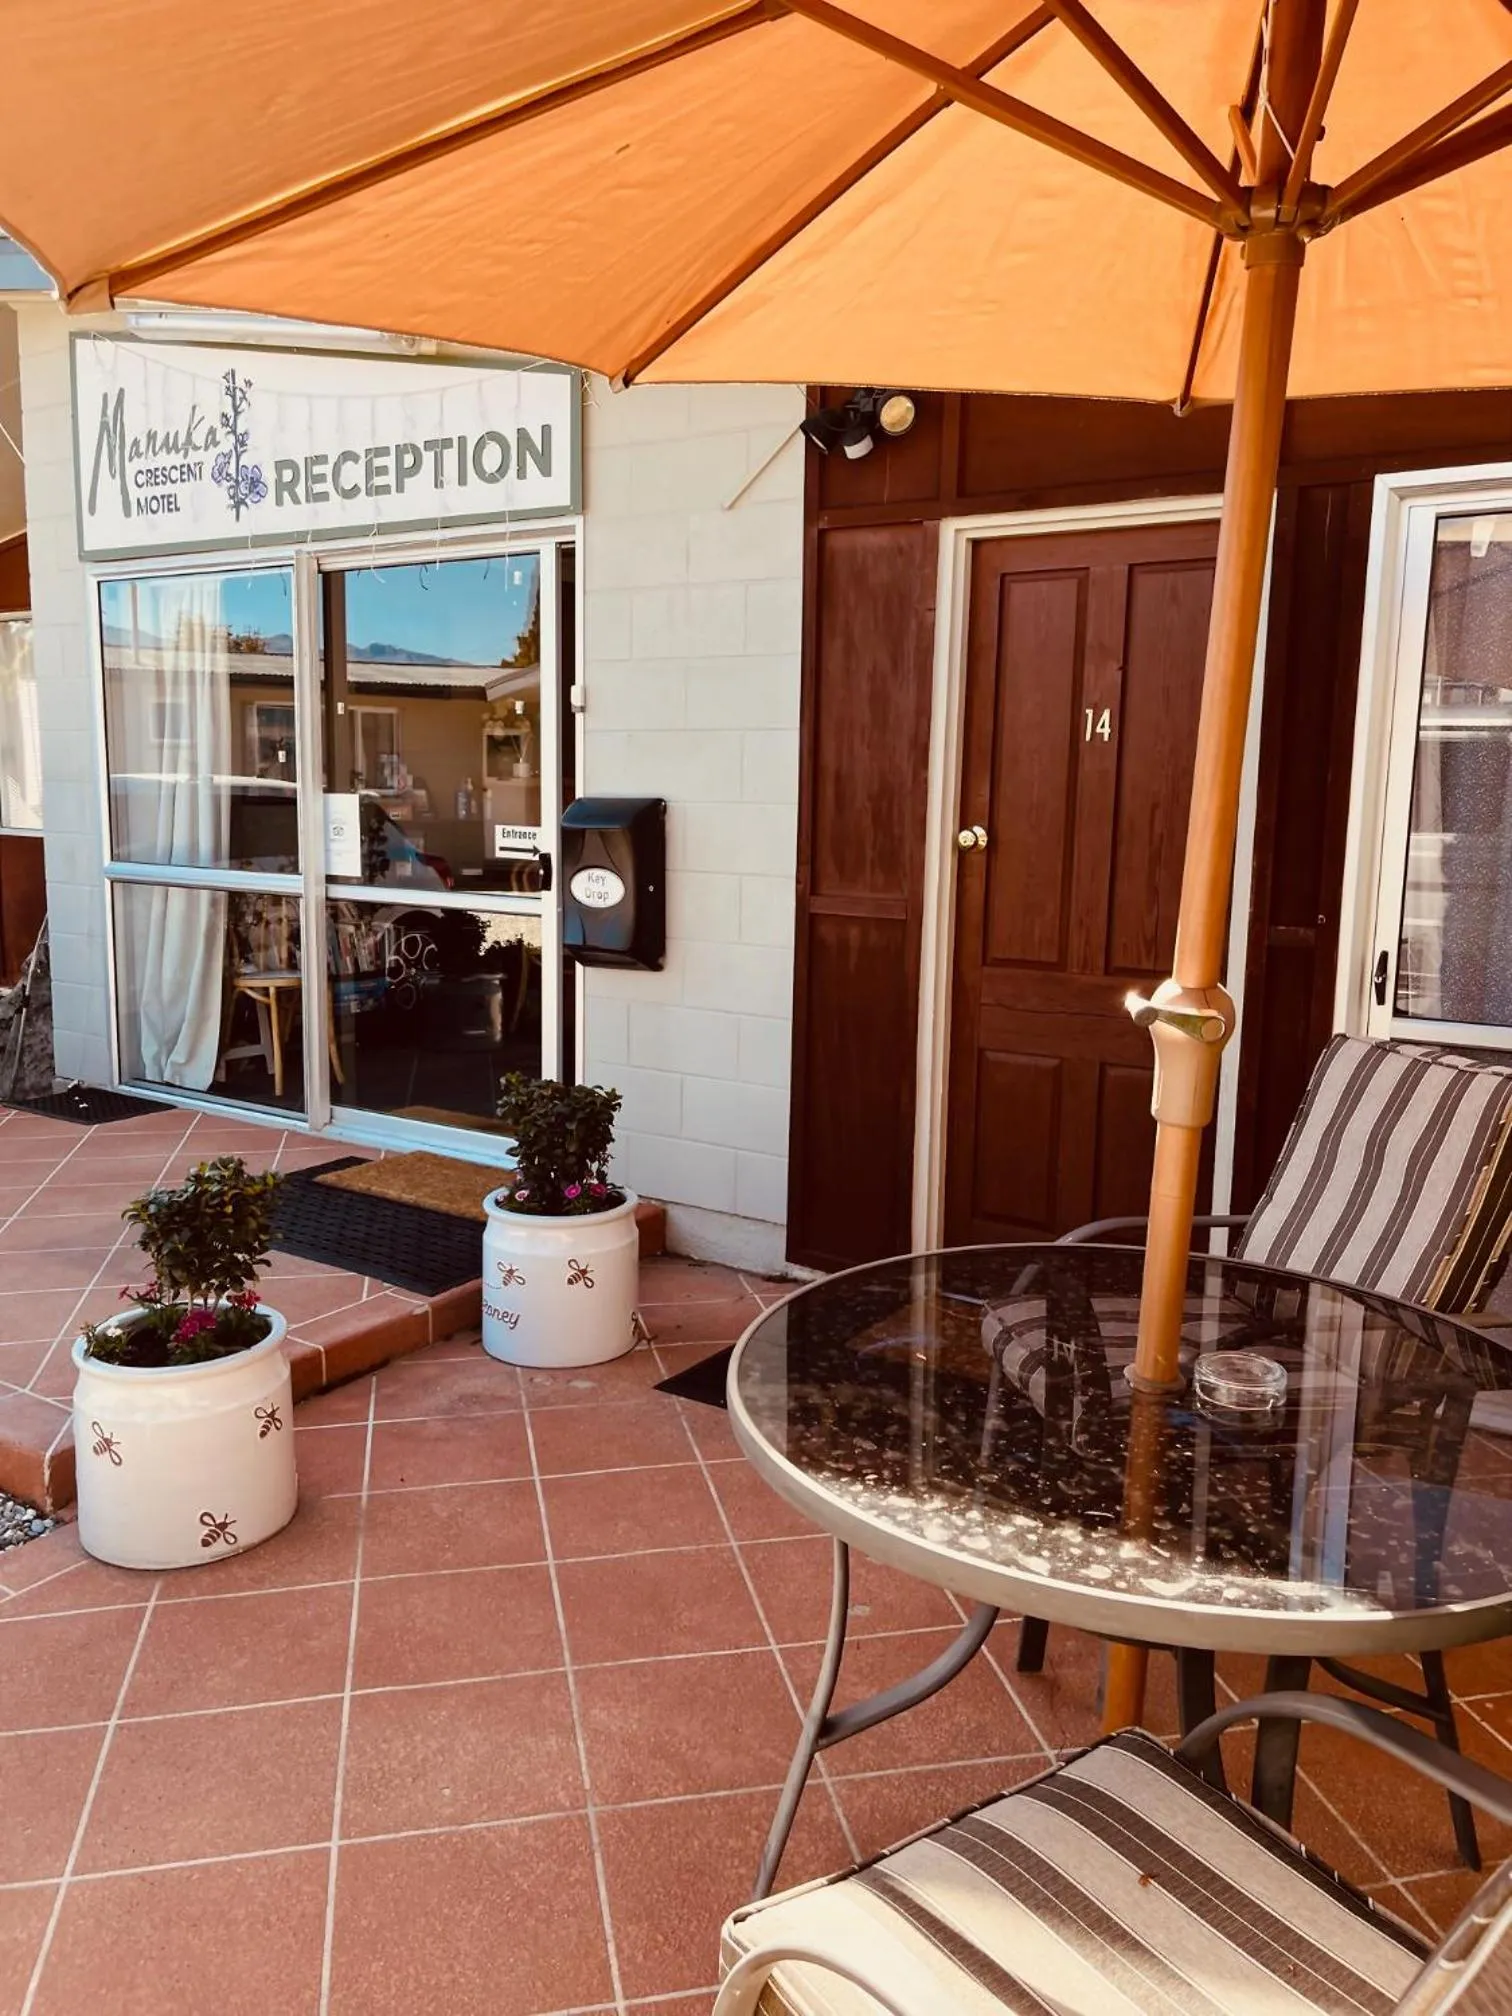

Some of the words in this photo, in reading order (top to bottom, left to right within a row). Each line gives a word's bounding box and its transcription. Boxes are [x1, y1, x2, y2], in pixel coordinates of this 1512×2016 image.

[134, 461, 204, 489] CRESCENT
[274, 424, 553, 507] RECEPTION
[136, 492, 181, 517] MOTEL
[1085, 708, 1111, 742] 14
[502, 827, 537, 840] Entrance
[588, 871, 607, 886] Key
[585, 887, 609, 902] Drop
